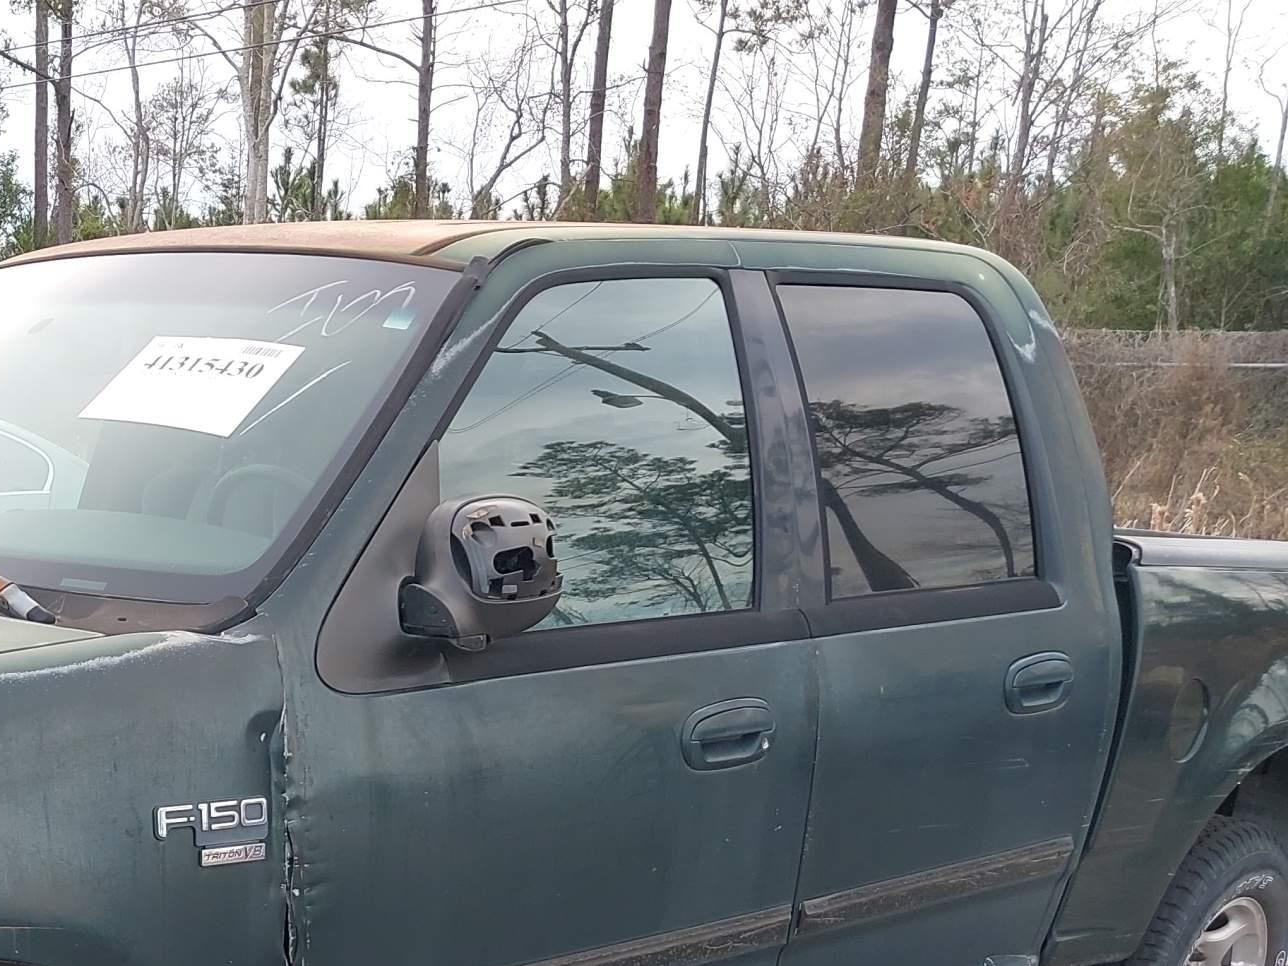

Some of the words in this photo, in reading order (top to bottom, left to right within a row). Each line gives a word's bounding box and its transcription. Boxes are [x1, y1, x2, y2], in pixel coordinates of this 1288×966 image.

[143, 354, 265, 379] 41315430
[157, 797, 268, 838] F-150
[204, 850, 242, 861] TRITON
[242, 845, 262, 859] V8
